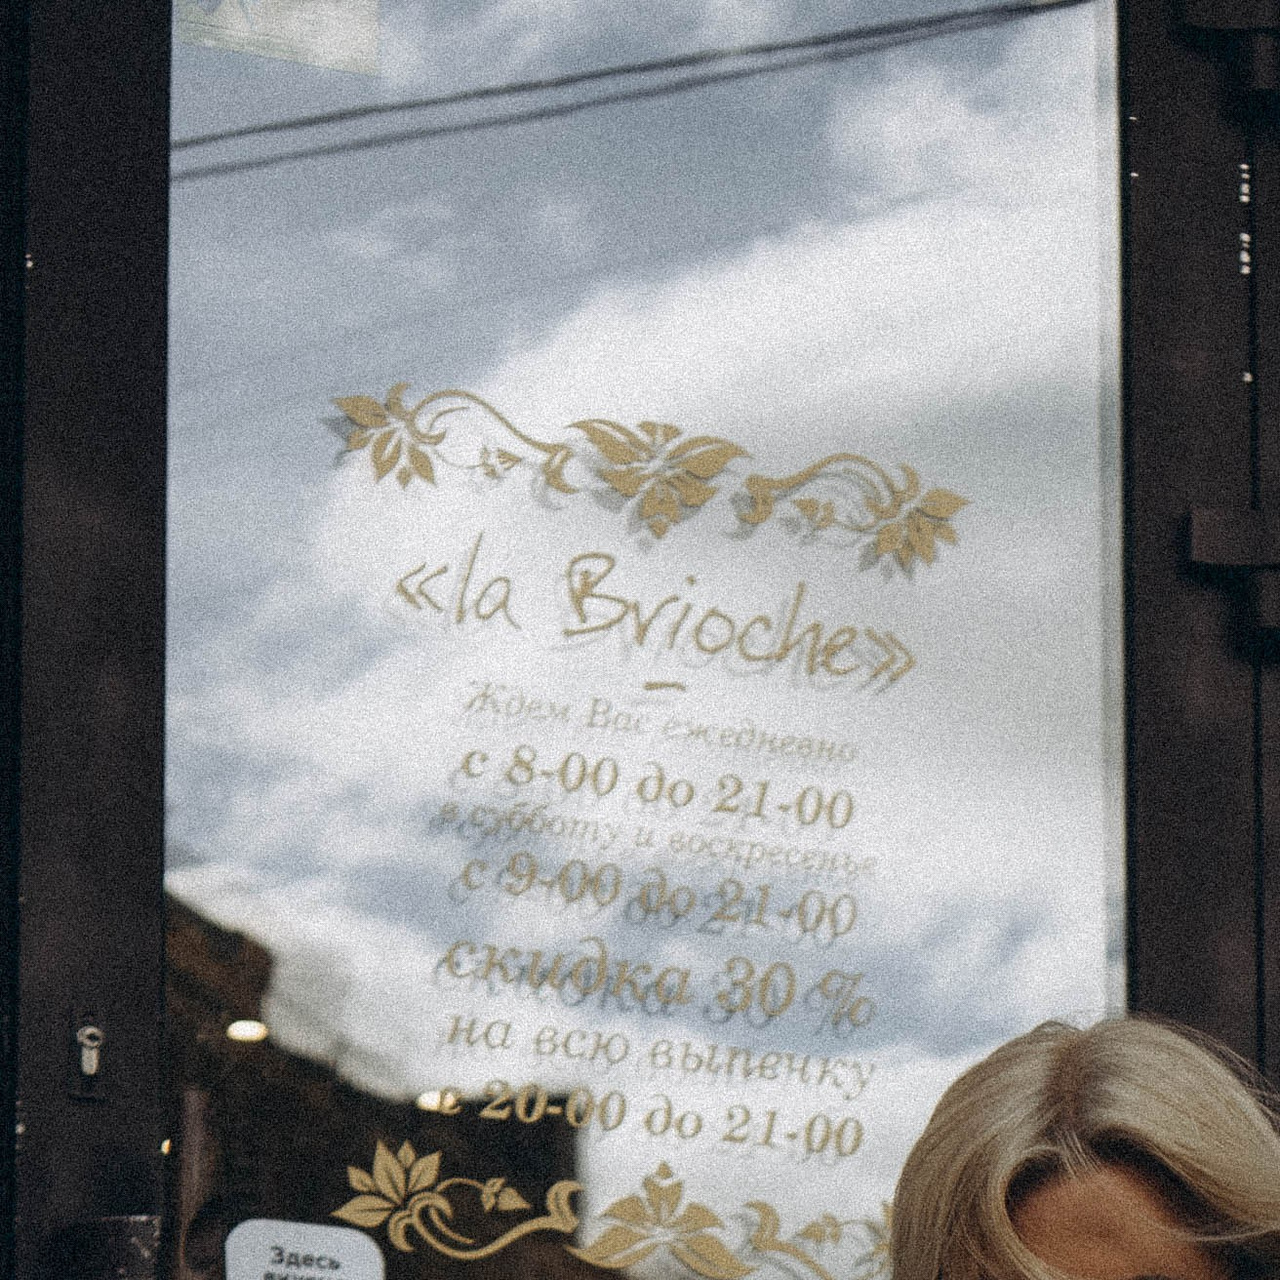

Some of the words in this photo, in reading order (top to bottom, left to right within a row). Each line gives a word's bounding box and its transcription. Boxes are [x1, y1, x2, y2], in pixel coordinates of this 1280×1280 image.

[660, 717, 857, 765] ежедневно
[461, 749, 489, 779] с
[505, 743, 619, 797] 8-00
[635, 760, 695, 808] до
[712, 773, 854, 829] 21-00
[471, 801, 621, 852] субботу
[461, 858, 489, 891] с
[505, 851, 623, 908] 9-00
[639, 866, 696, 917] до
[713, 877, 858, 937] 21-00
[444, 935, 693, 1004] скидка
[718, 956, 797, 1019] 30
[819, 968, 876, 1028] %
[446, 1013, 513, 1050] на
[534, 1024, 630, 1066] всю
[647, 1037, 876, 1101] выпечку
[478, 1078, 628, 1132] 20-00
[643, 1094, 703, 1140] до
[723, 1103, 864, 1158] 21-00
[269, 1245, 341, 1272] Здесь
